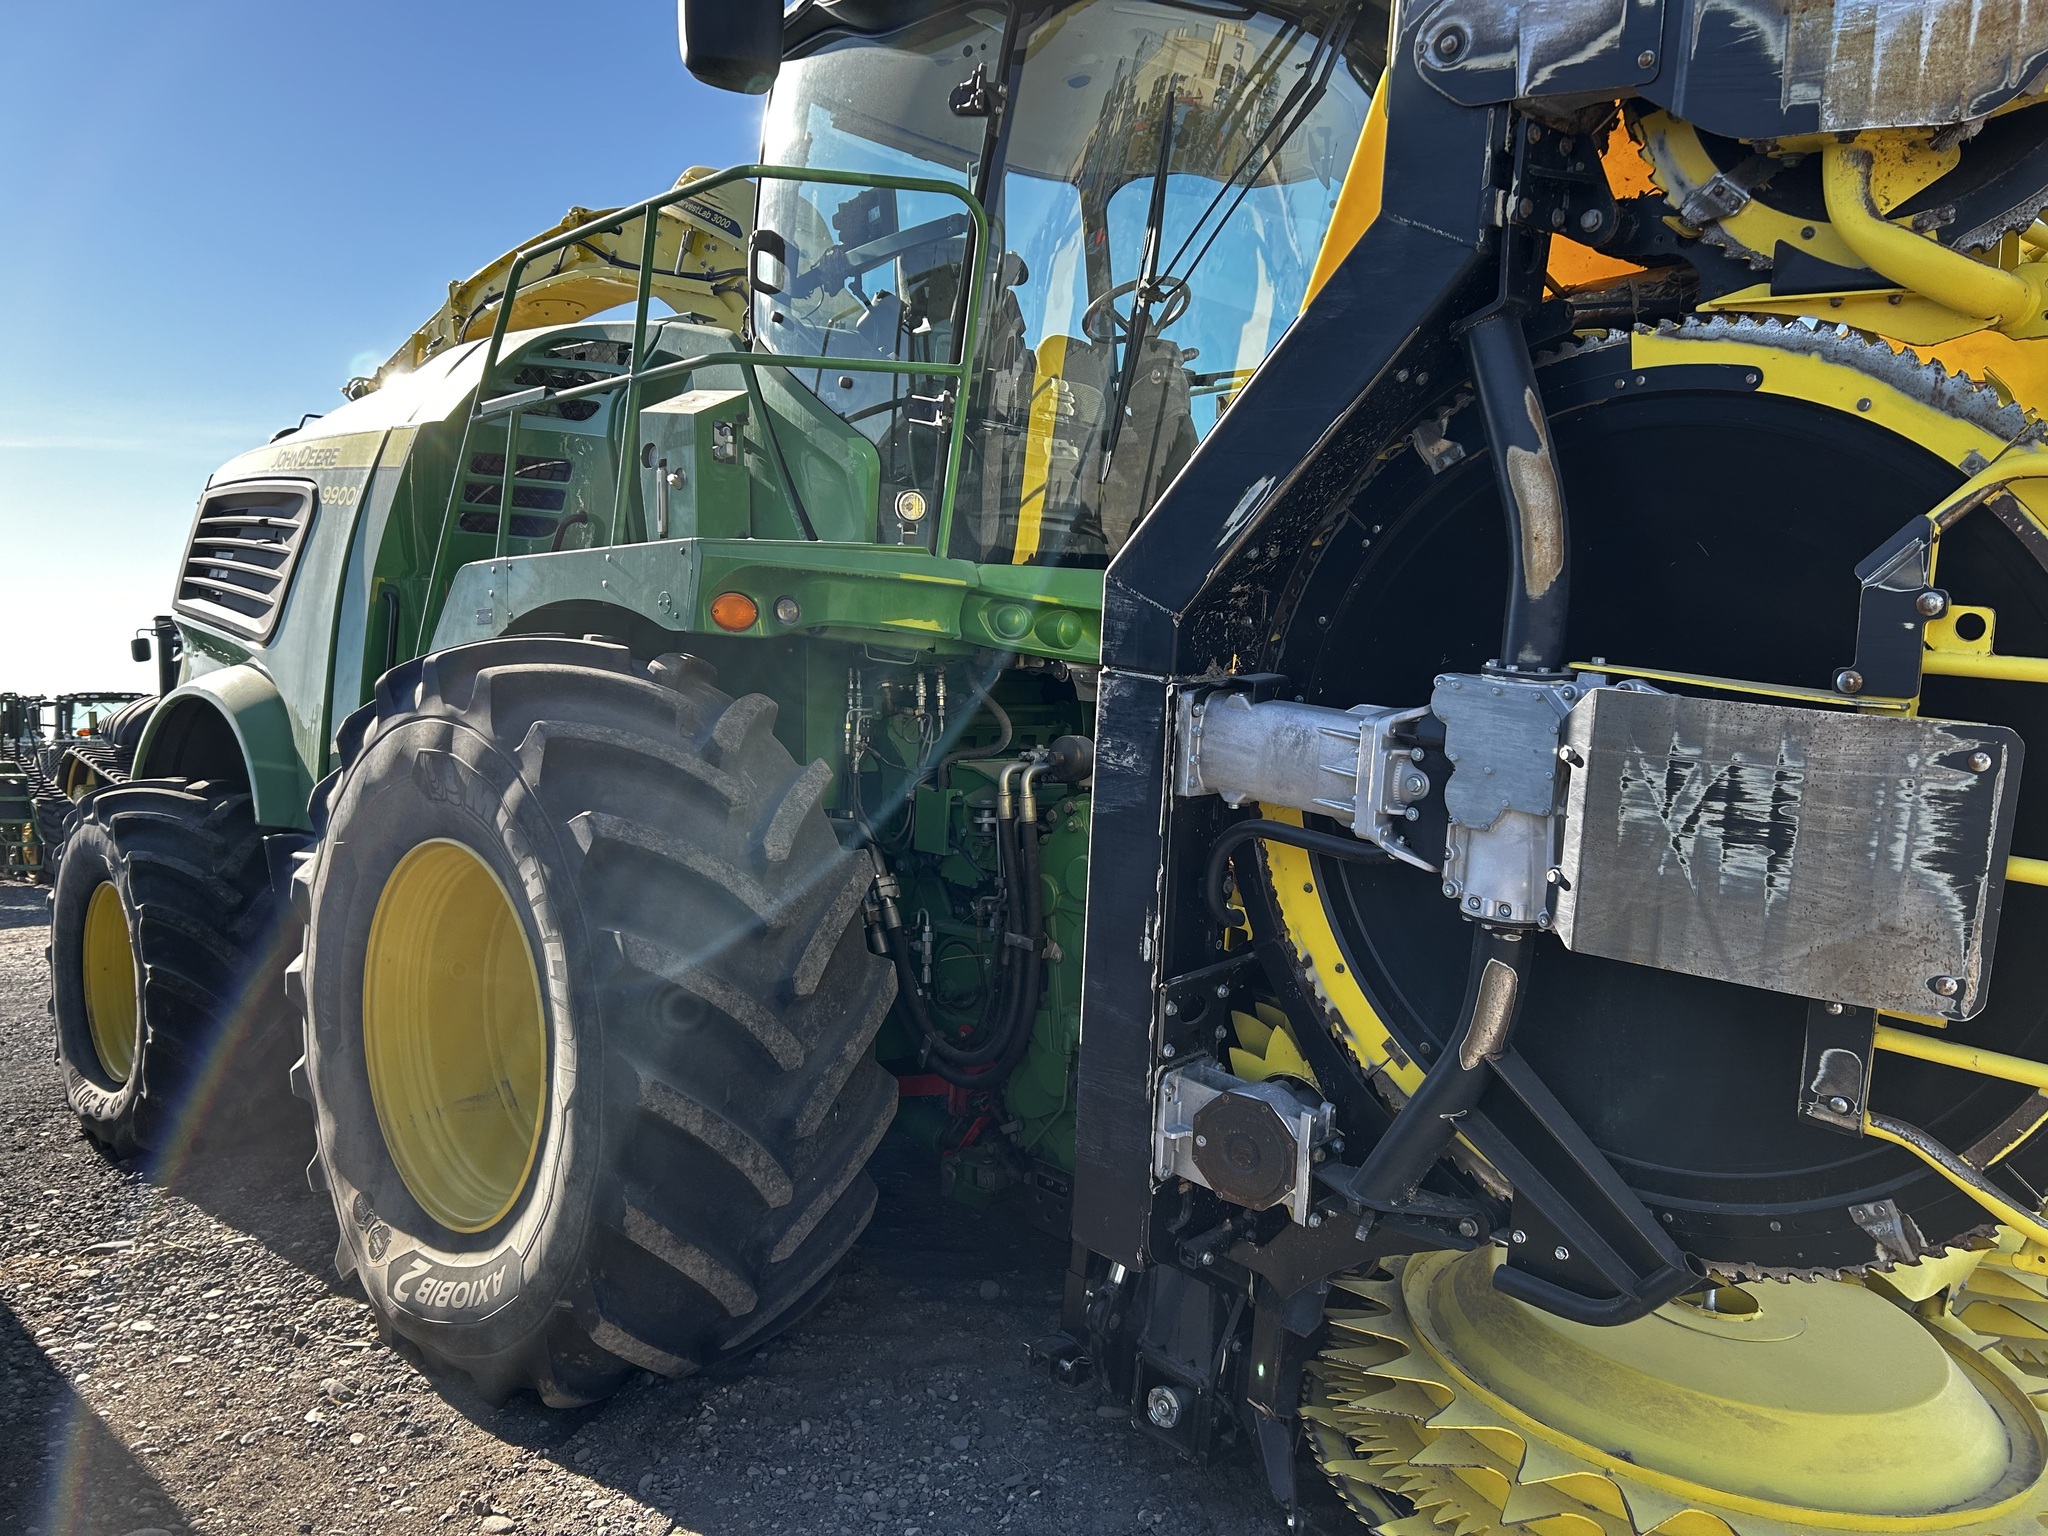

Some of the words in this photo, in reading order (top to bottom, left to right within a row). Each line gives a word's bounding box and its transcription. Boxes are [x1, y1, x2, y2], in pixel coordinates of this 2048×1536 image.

[677, 200, 711, 219] arvestLab
[711, 214, 731, 229] 3000
[271, 447, 302, 468] JOHN
[300, 446, 341, 467] DEERE
[393, 1258, 433, 1303] 2
[414, 1264, 507, 1309] AXIOBIB
